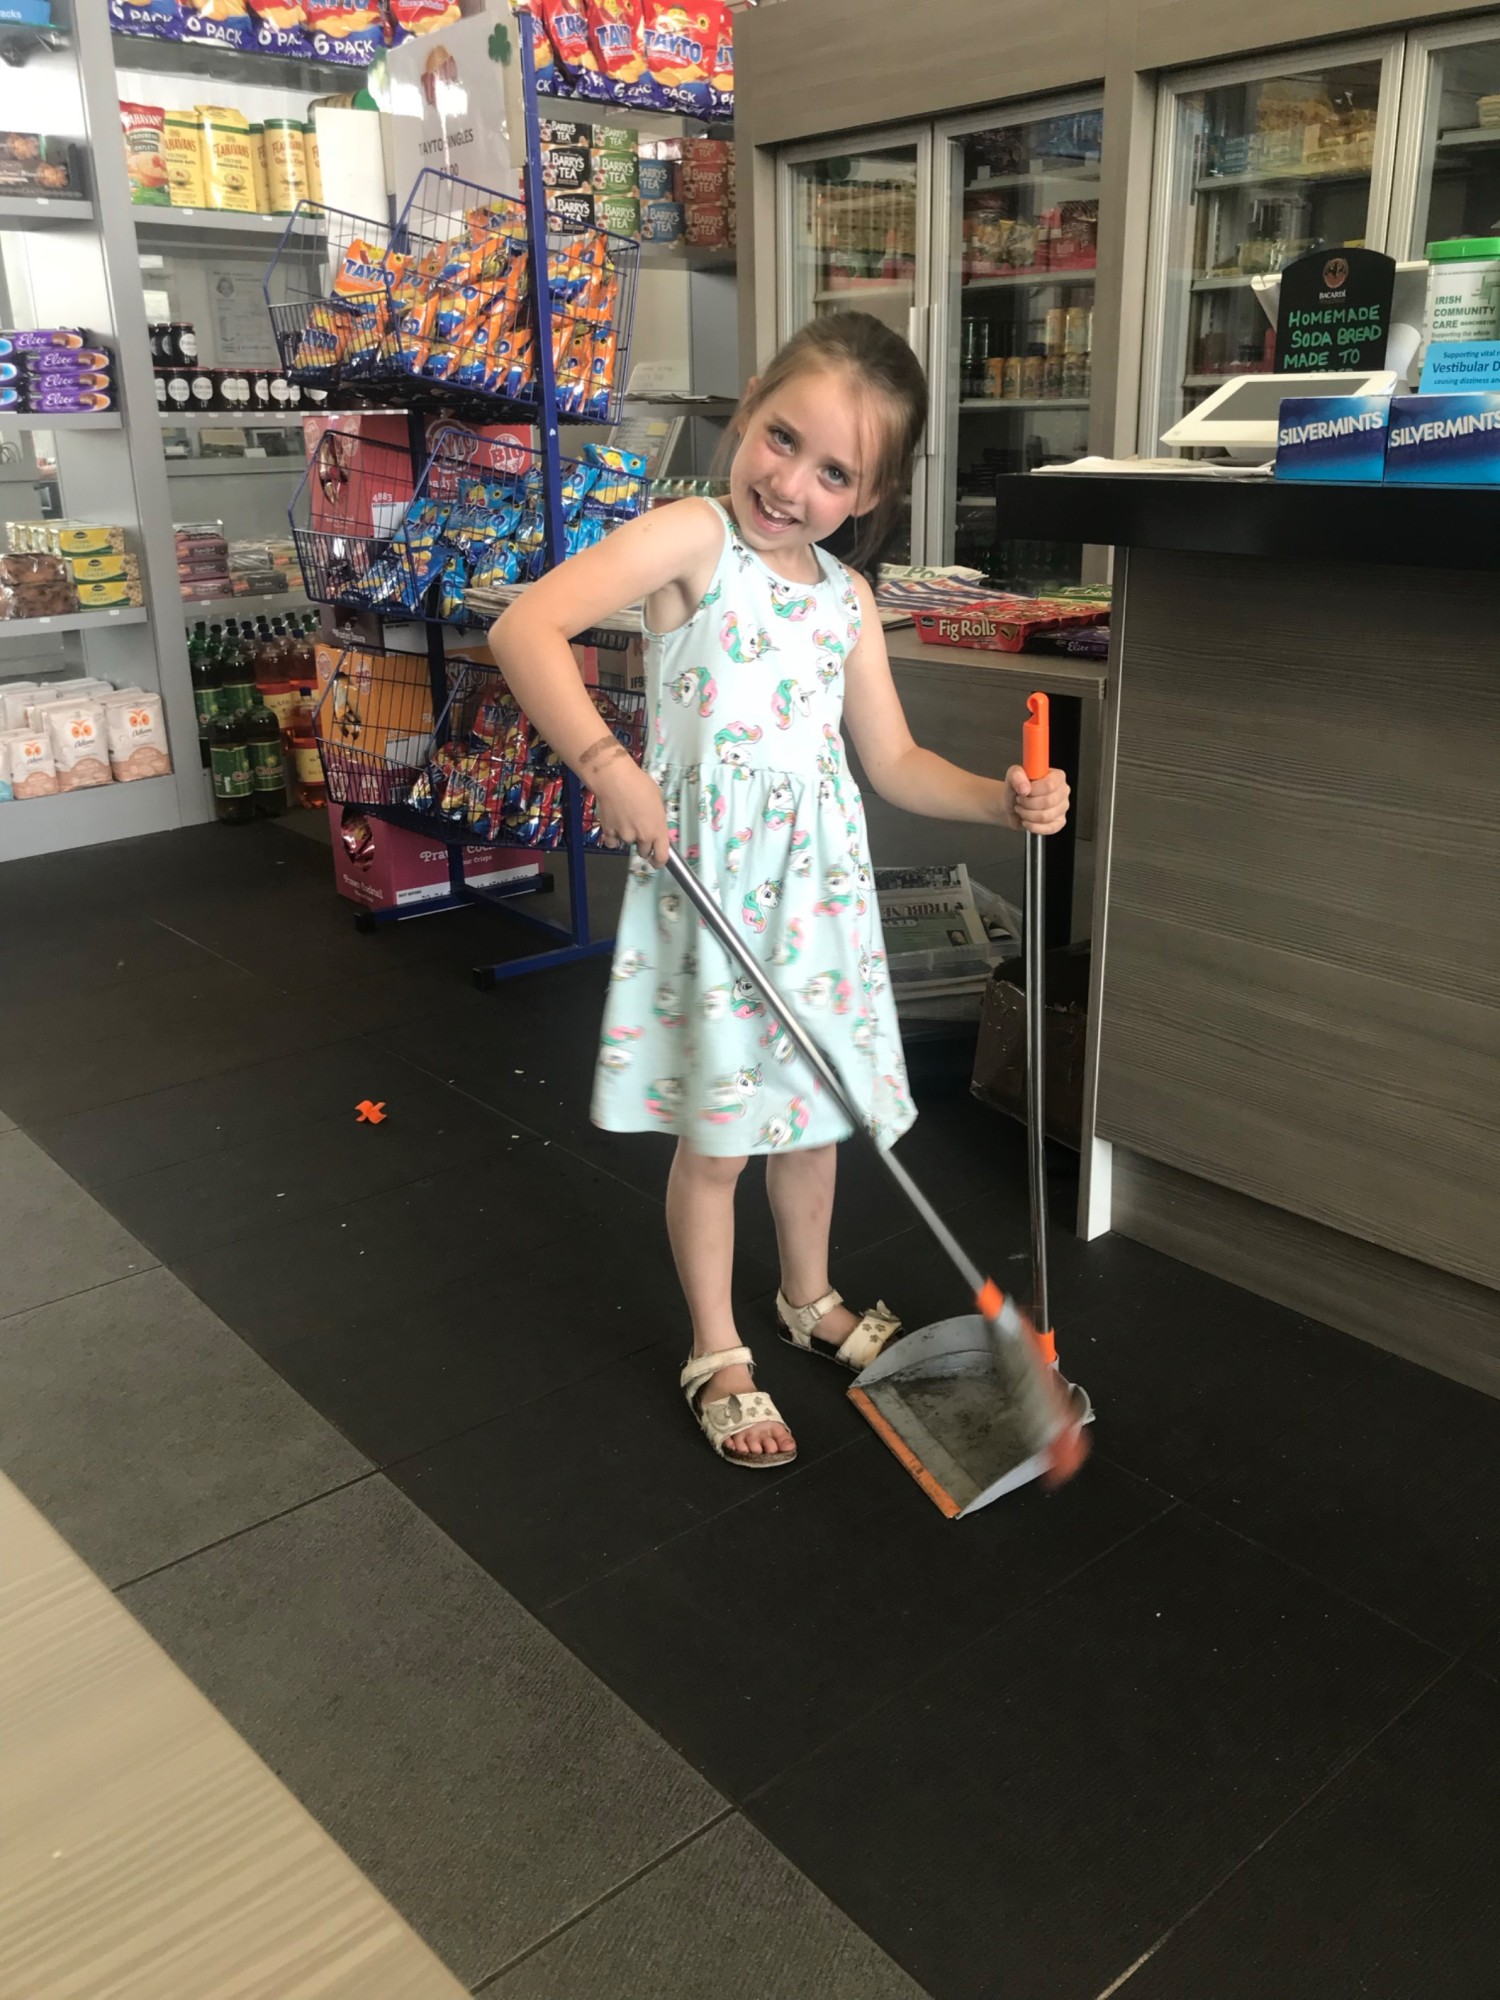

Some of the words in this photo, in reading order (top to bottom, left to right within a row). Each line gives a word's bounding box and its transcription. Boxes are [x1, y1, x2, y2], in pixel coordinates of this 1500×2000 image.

[206, 23, 242, 45] PACK
[313, 34, 330, 55] 6
[335, 39, 375, 58] PACK
[643, 29, 703, 63] TAYTO
[418, 138, 444, 156] TAYTO
[445, 128, 474, 148] INGLES
[557, 132, 571, 140] TEA
[610, 137, 623, 146] TEA
[552, 153, 585, 171] BARRY'S
[602, 158, 634, 176] BARRY'S
[559, 168, 577, 179] TEA
[609, 172, 627, 183] TEA
[642, 179, 659, 189] TEA
[698, 182, 715, 193] TEA
[558, 199, 590, 217] BARRY'S
[605, 204, 636, 222] BARRY'S
[611, 219, 628, 229] TEA
[656, 221, 672, 232] TEA
[700, 226, 717, 236] TEA
[343, 259, 396, 287] TAYTO
[1435, 295, 1462, 305] IRISH
[1288, 304, 1380, 328] HOMEMADE
[1433, 306, 1495, 317] COMMUNITY
[1432, 320, 1458, 329] CARE
[1290, 330, 1332, 348] SODA
[1337, 325, 1382, 345] BREAD
[1283, 352, 1329, 369] MADE
[1339, 349, 1360, 364] TO
[1443, 350, 1479, 359] Supporting
[1432, 360, 1489, 373] Vestibular
[1433, 377, 1458, 385] causing
[1459, 376, 1489, 384] dizziness
[1279, 411, 1384, 447] SILVERMINTS
[939, 619, 960, 641] Fig
[961, 616, 996, 637] Rolls
[1067, 641, 1089, 652] Elite
